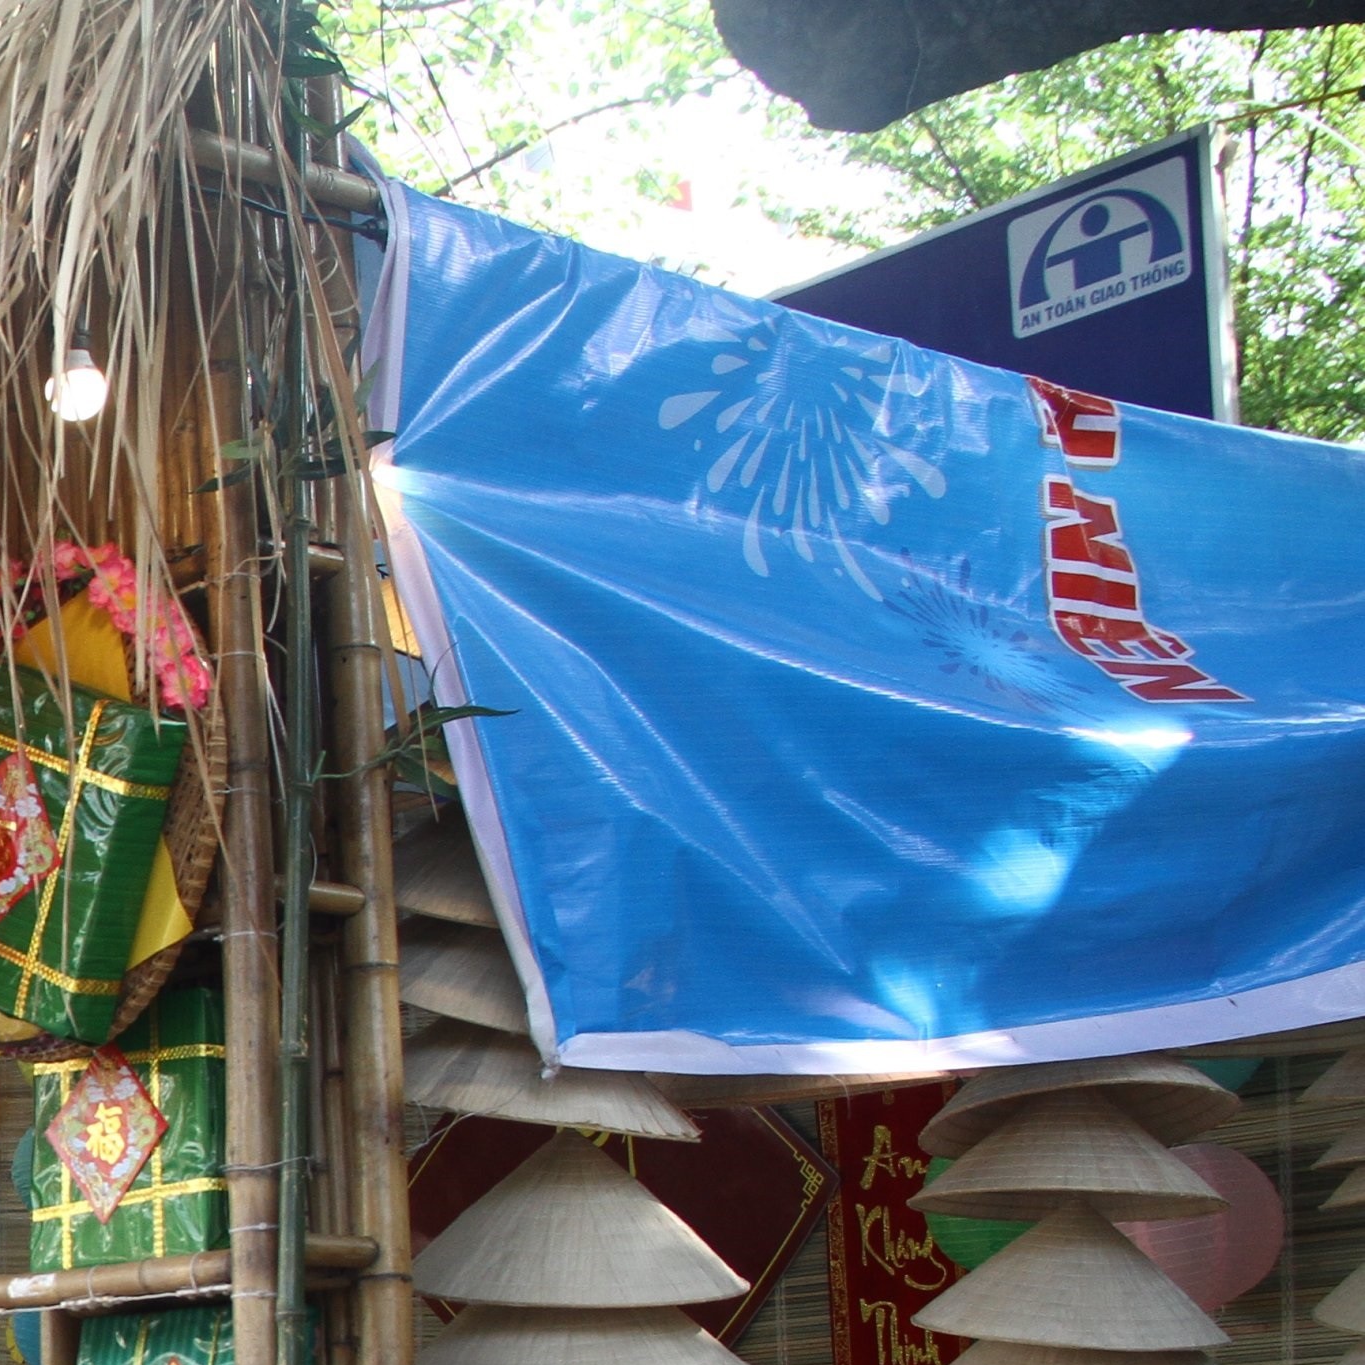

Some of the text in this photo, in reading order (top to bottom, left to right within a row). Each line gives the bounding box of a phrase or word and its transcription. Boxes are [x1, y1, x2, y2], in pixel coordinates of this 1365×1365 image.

[1021, 260, 1185, 330] AN TOÀN GIAO THÔNG
[860, 1125, 928, 1190] An
[855, 1203, 947, 1291] Khang
